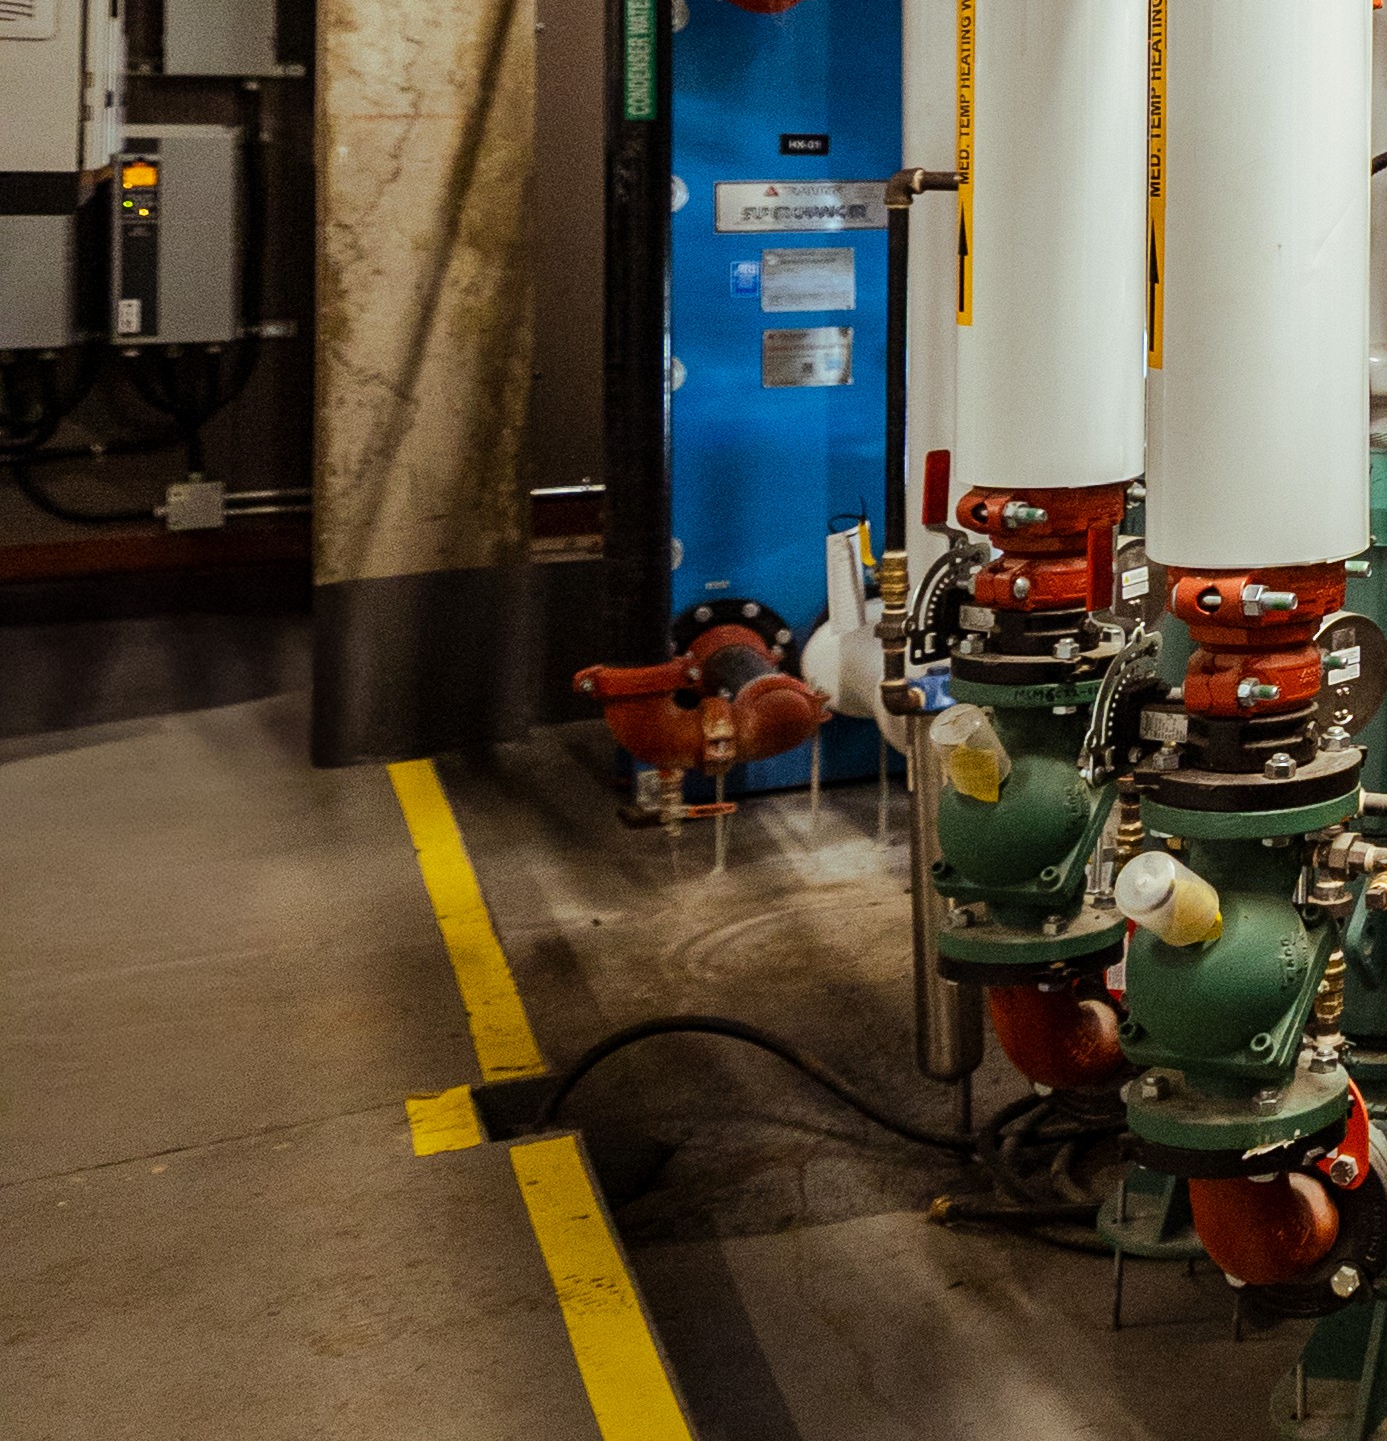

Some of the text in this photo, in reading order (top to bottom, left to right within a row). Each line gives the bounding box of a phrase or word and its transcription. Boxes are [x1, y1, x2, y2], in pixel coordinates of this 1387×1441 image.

[627, 37, 651, 116] CONDENSER
[959, 15, 972, 89] HEATING
[958, 94, 971, 138] TEMP
[1149, 86, 1162, 140] TEMP
